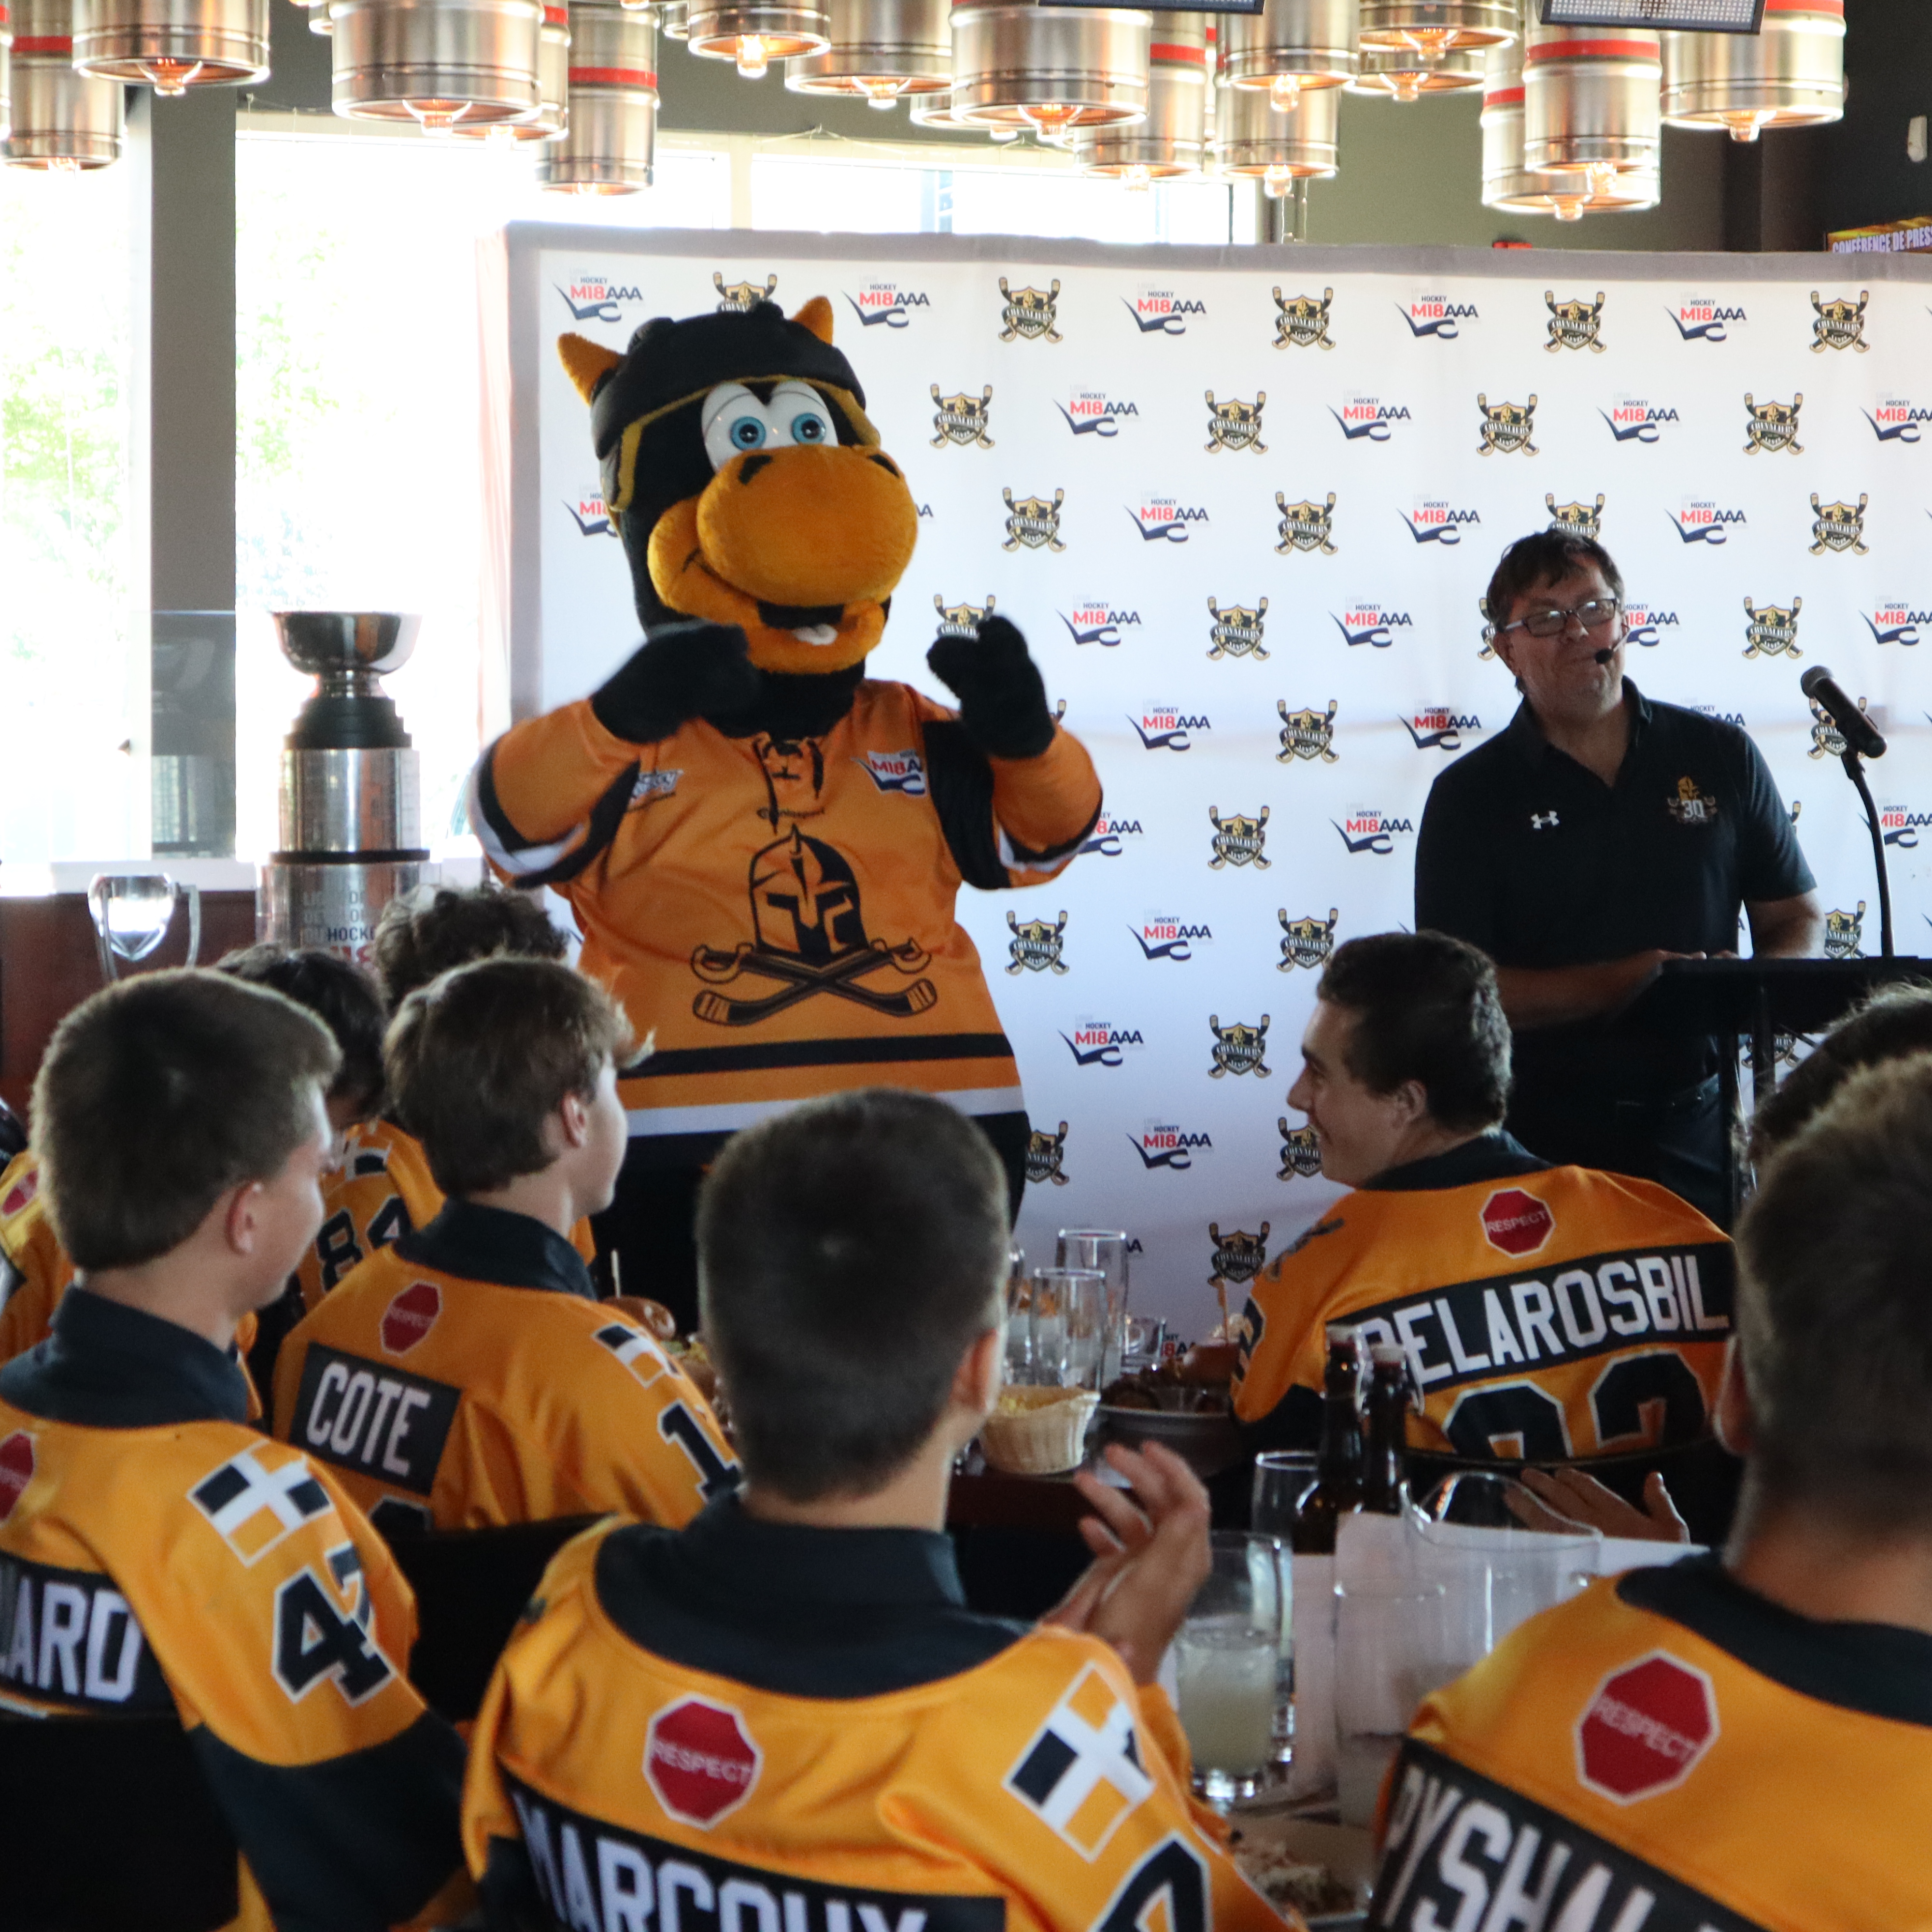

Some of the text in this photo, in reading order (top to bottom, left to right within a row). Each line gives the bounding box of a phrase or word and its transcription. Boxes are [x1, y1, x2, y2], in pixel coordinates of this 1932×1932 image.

[1892, 230, 1905, 251] DE
[1629, 612, 1679, 625] 18AAA
[871, 759, 923, 775] M18A
[1681, 800, 1705, 818] 30
[1095, 820, 1143, 834] 8AAA
[1486, 1210, 1546, 1233] RESPECT
[306, 1361, 431, 1477] COTE
[652, 1740, 750, 1787] RESPECT
